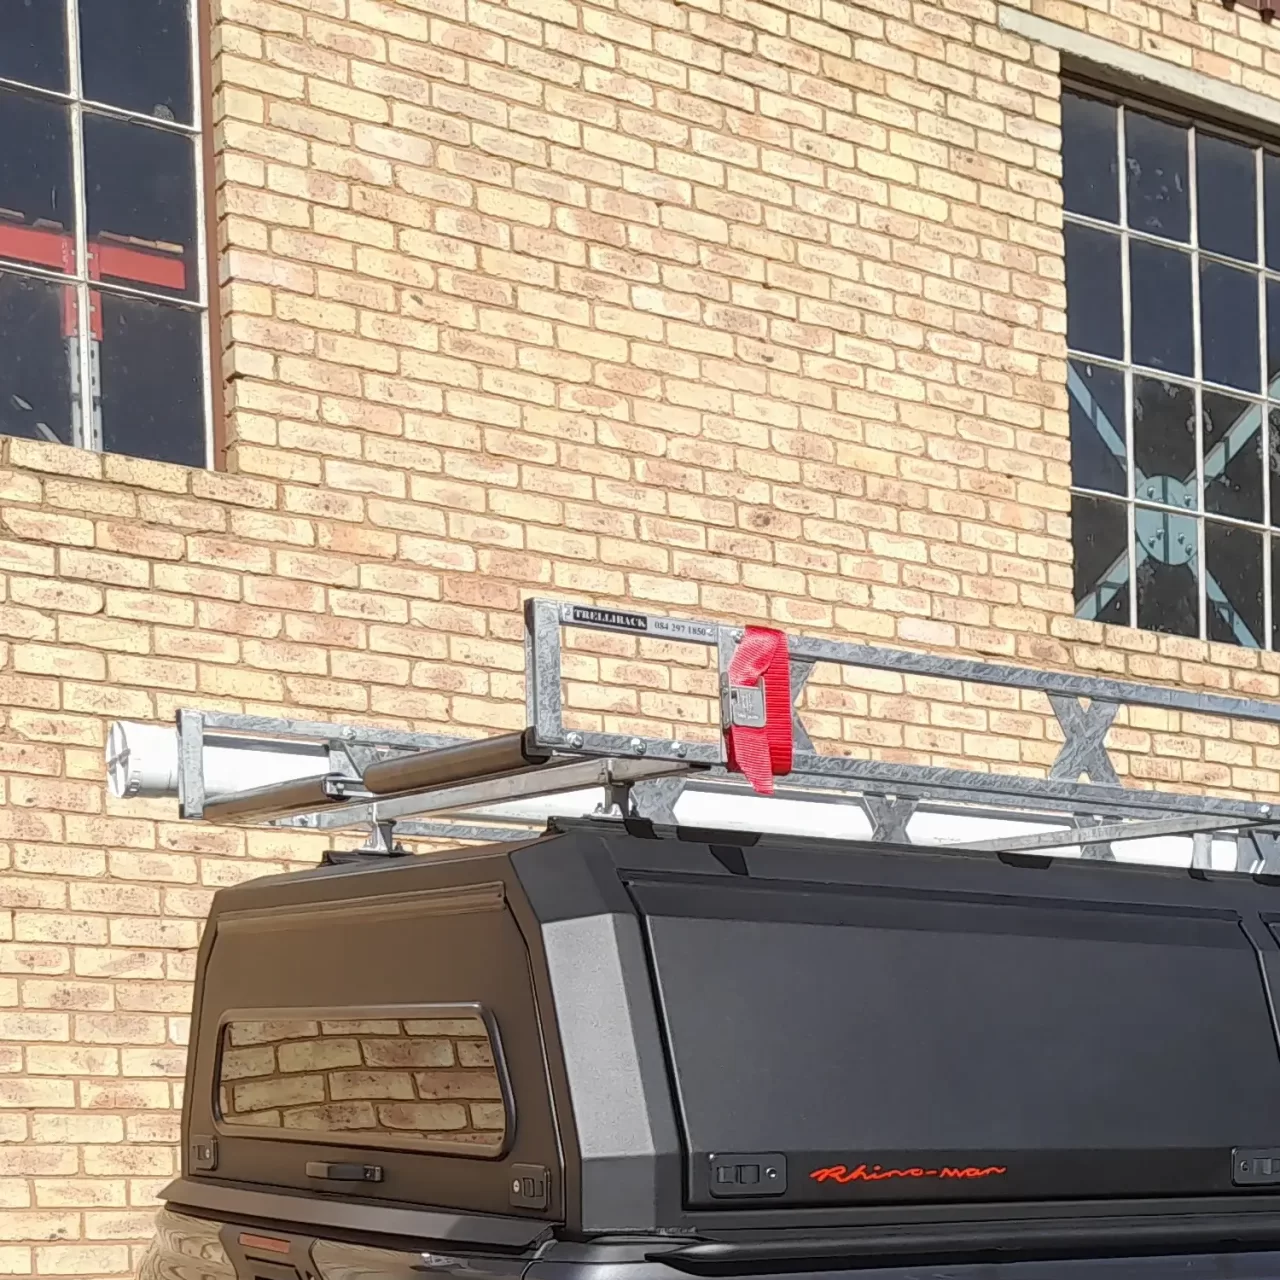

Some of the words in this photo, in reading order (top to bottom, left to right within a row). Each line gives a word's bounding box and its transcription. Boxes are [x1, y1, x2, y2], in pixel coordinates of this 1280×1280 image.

[574, 608, 646, 628] TRELLIRACK
[654, 620, 669, 631] 084
[671, 622, 686, 633] 297
[688, 625, 706, 636] 1850
[809, 1164, 1007, 1184] Rhino-man
